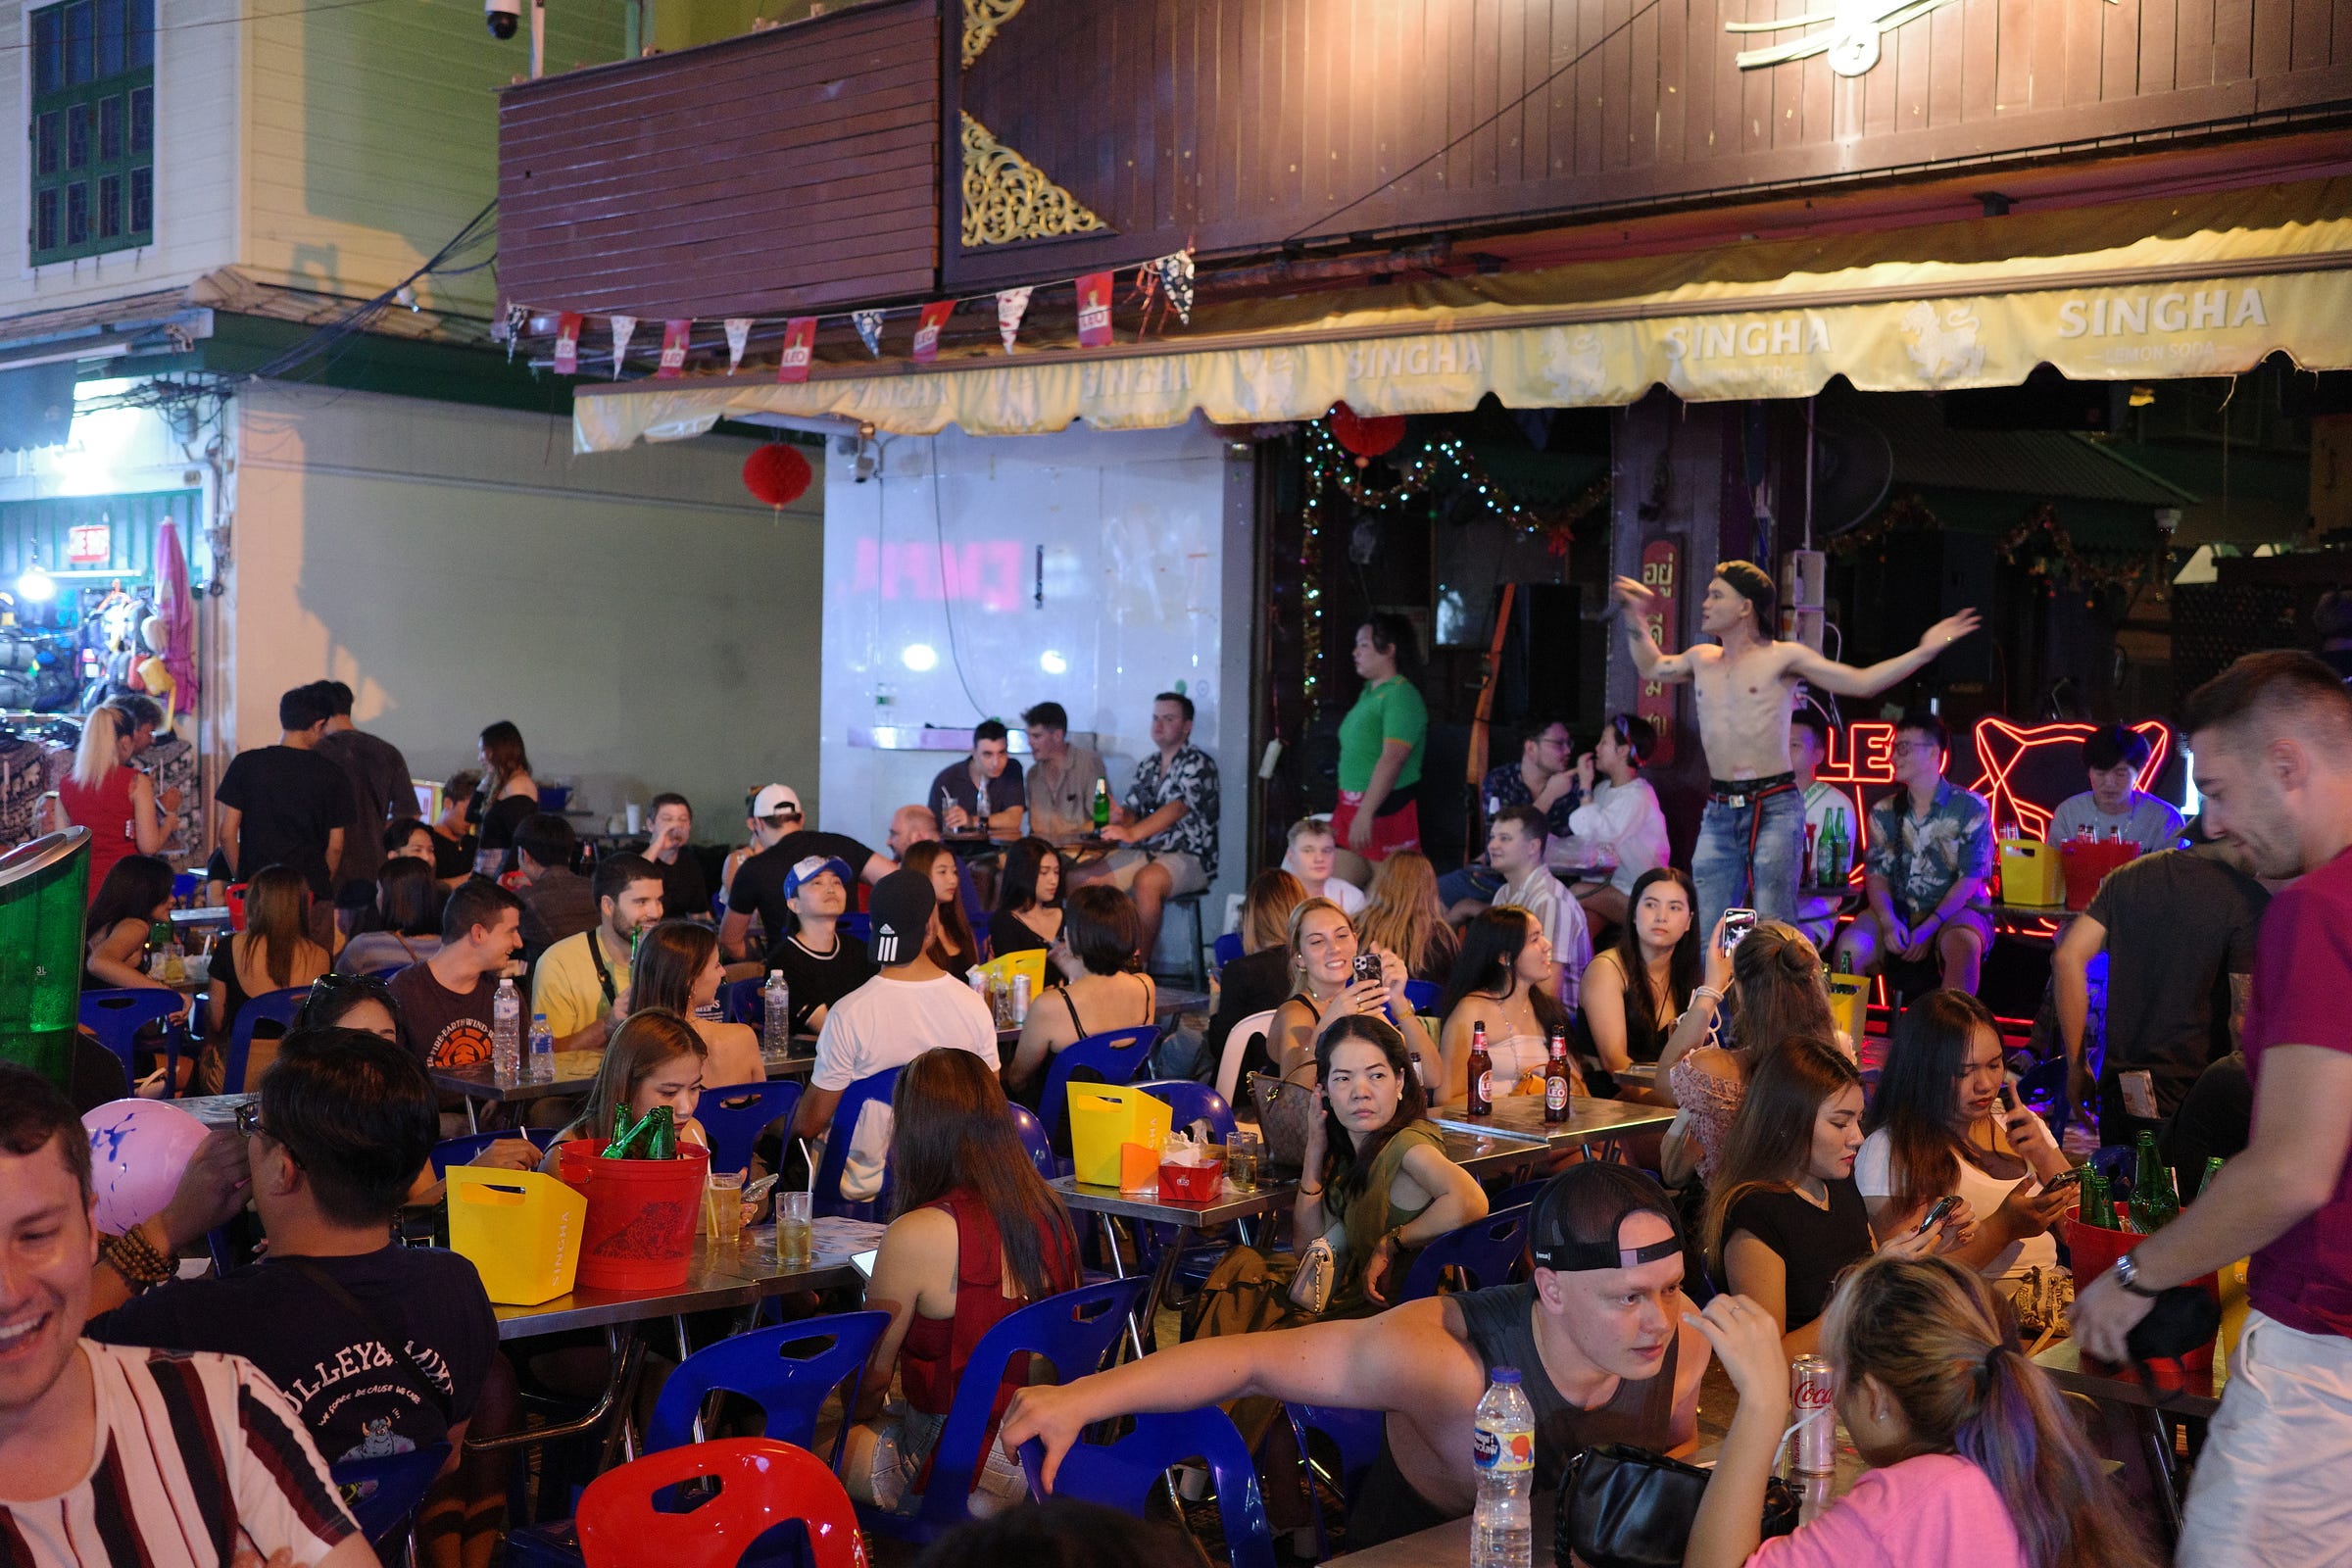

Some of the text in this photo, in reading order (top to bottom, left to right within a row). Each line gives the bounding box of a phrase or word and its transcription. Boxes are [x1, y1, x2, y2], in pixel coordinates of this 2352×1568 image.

[1081, 312, 1105, 327] LEO
[2059, 288, 2269, 338] SINGHA
[1665, 317, 1832, 361] SINGHA
[664, 353, 683, 364] LEO
[785, 351, 806, 363] LEO
[1347, 341, 1484, 379] SINGHA
[2105, 342, 2216, 364] LEMON SODA
[35, 965, 47, 975] 3L
[430, 1018, 488, 1055] FIRE EARTH WIND
[1547, 1088, 1566, 1098] LEO
[1177, 1178, 1190, 1187] LEO
[552, 1210, 571, 1287] SINGHA
[355, 1384, 394, 1397] BECAUSE
